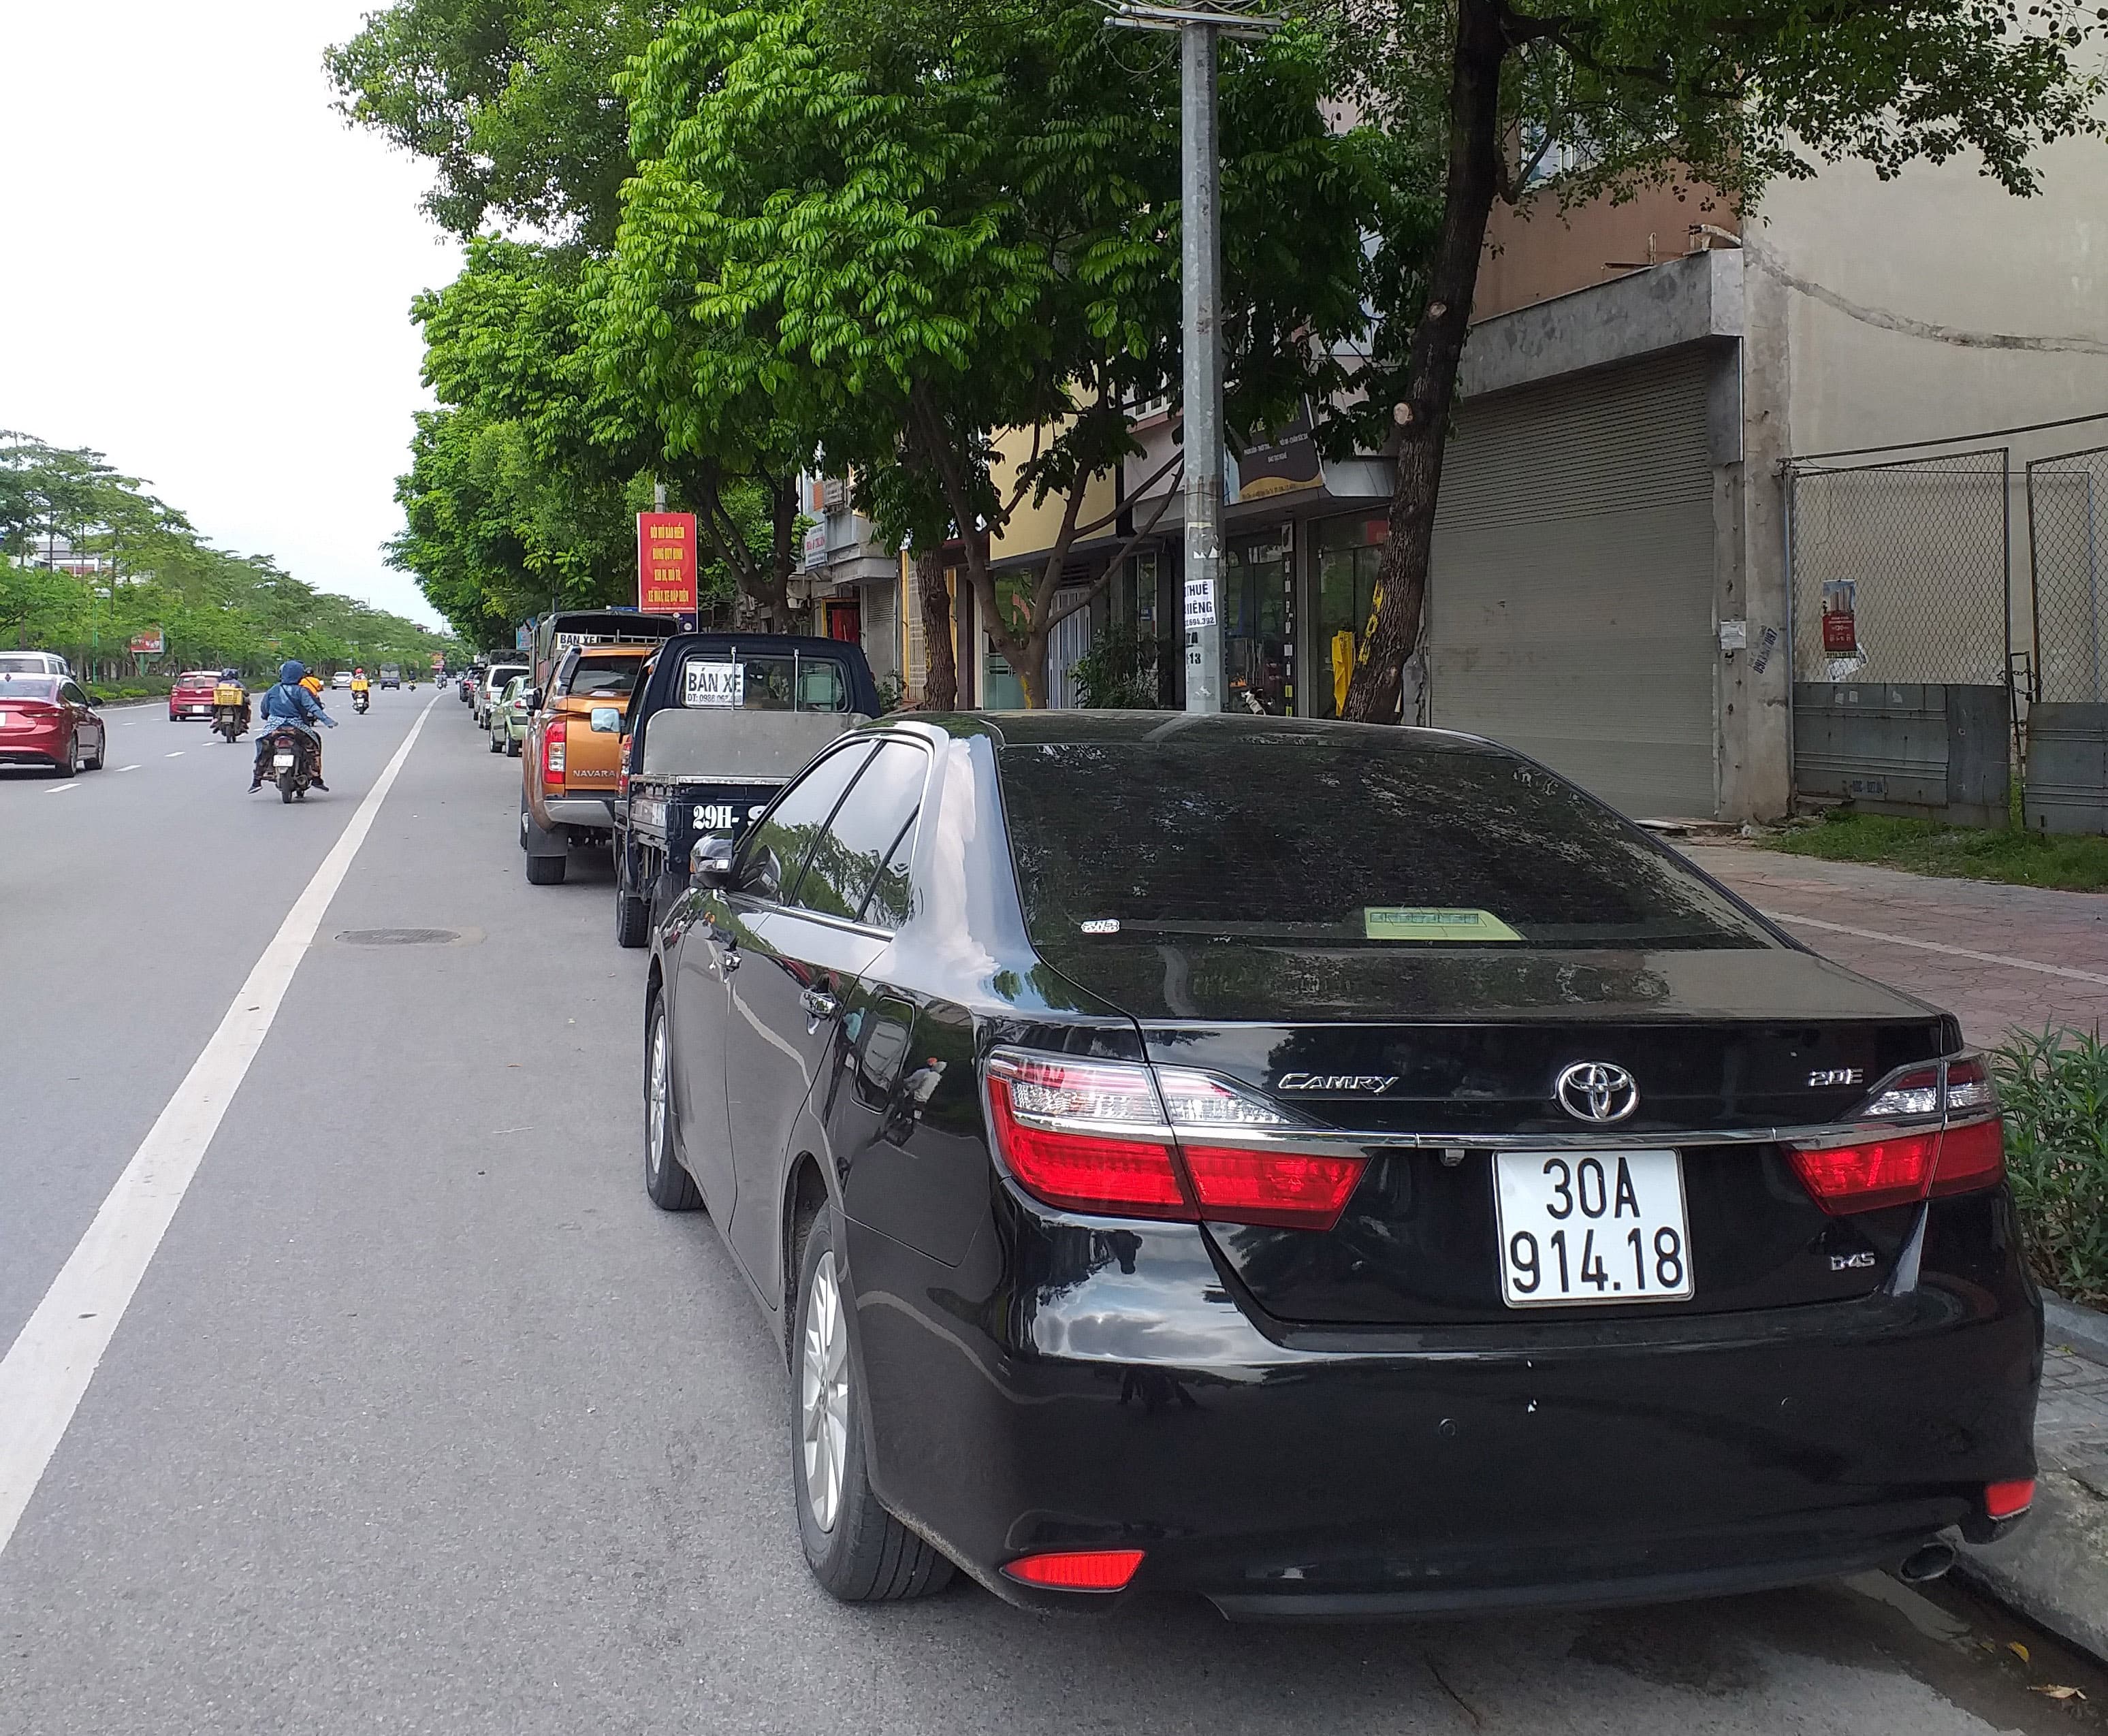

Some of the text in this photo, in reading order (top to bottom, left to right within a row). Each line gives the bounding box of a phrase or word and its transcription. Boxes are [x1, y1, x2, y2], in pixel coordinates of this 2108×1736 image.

[688, 667, 741, 693] BÁN XE
[1278, 1073, 1399, 1093] CAMRY
[1543, 1157, 1640, 1219] 30A
[1510, 1226, 1683, 1293] 914.18
